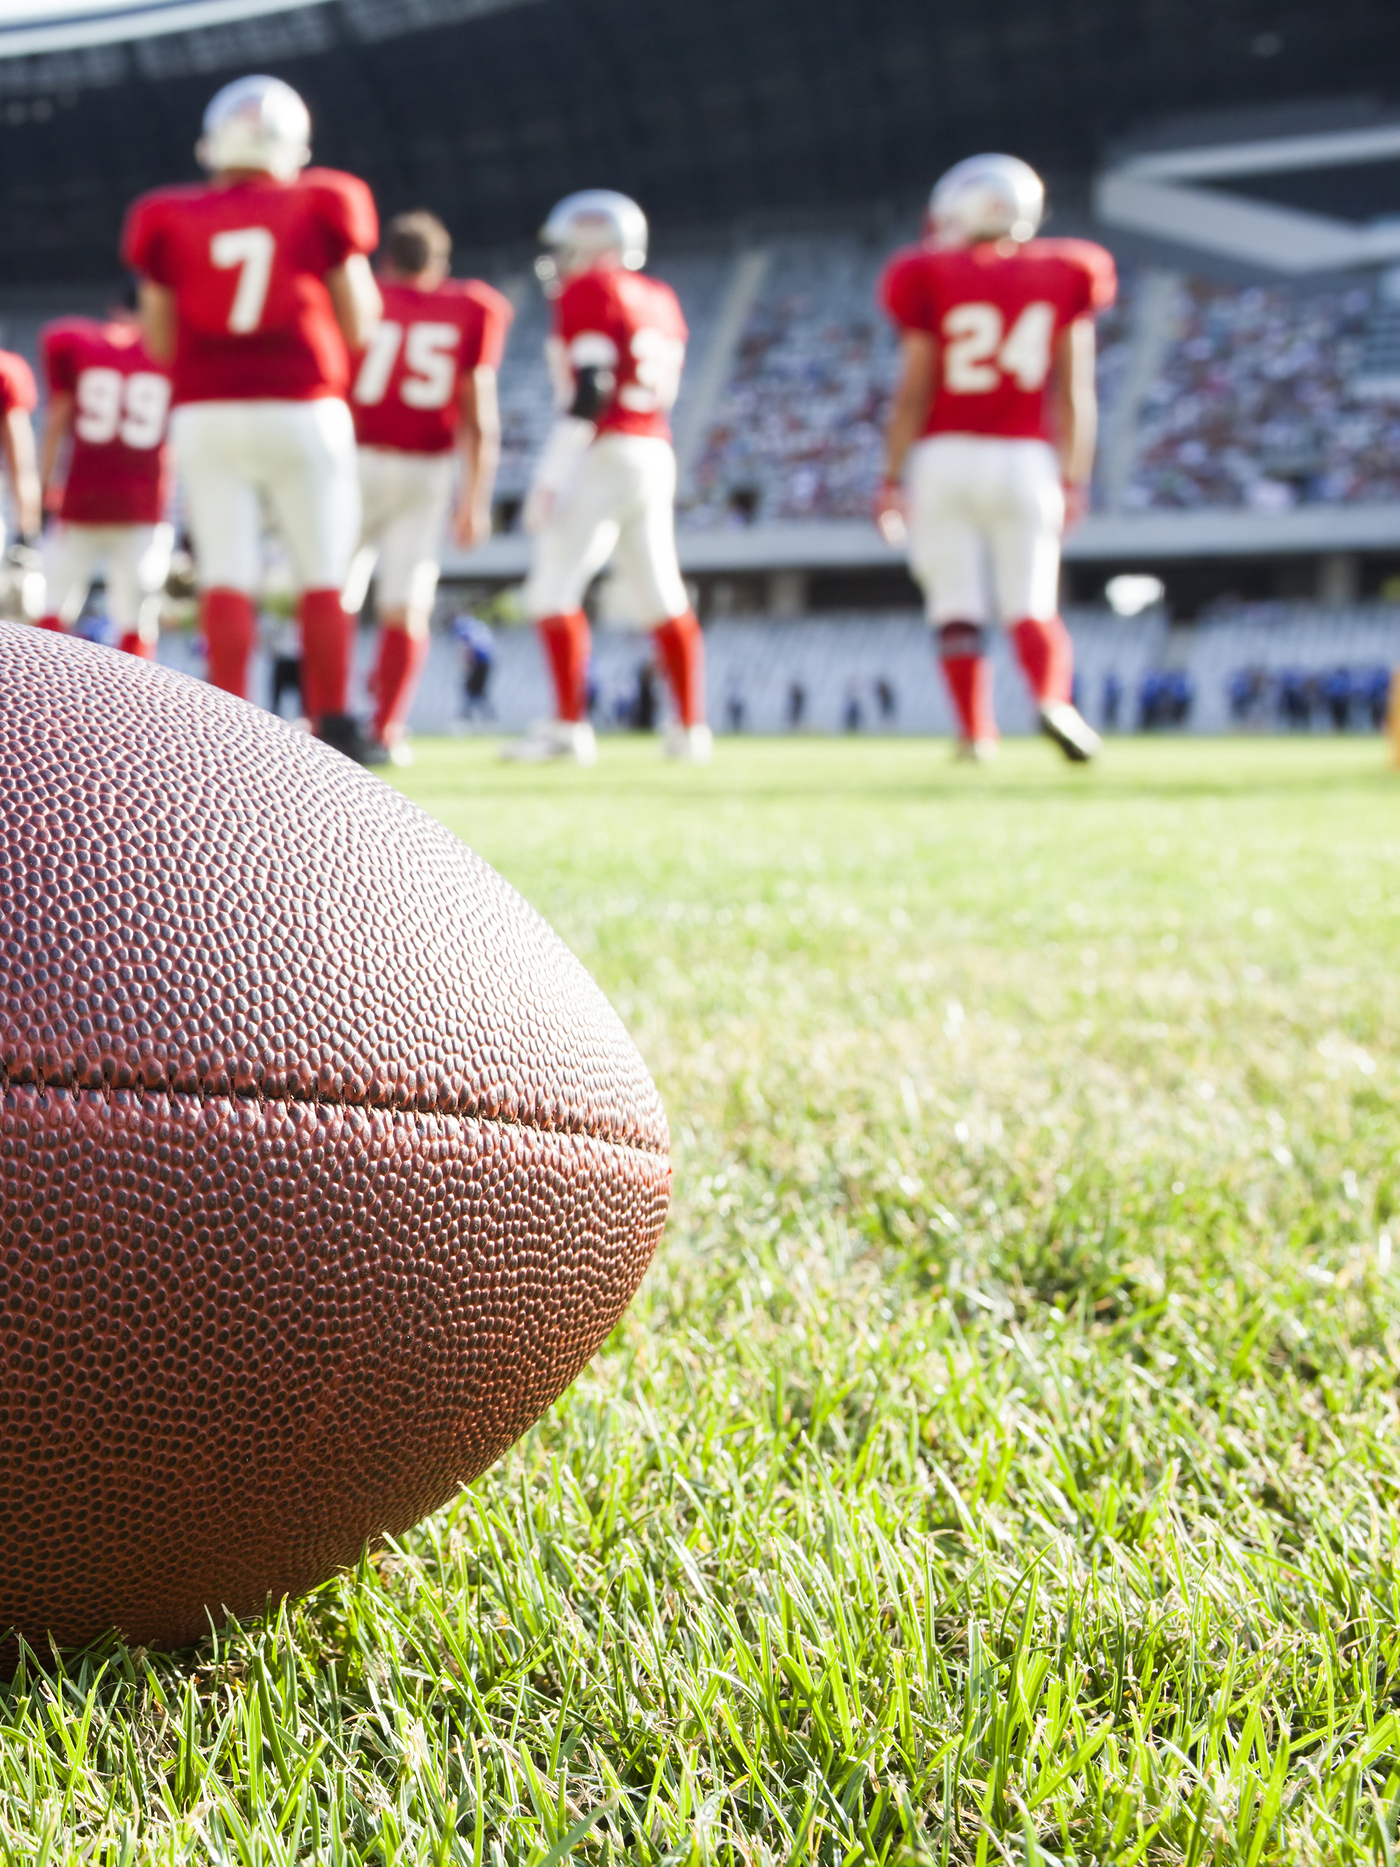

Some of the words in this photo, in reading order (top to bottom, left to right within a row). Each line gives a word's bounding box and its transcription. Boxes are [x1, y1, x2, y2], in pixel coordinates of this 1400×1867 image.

[209, 226, 275, 334] 7
[352, 320, 461, 409] 75
[940, 301, 1057, 394] 24
[76, 367, 173, 451] 99
